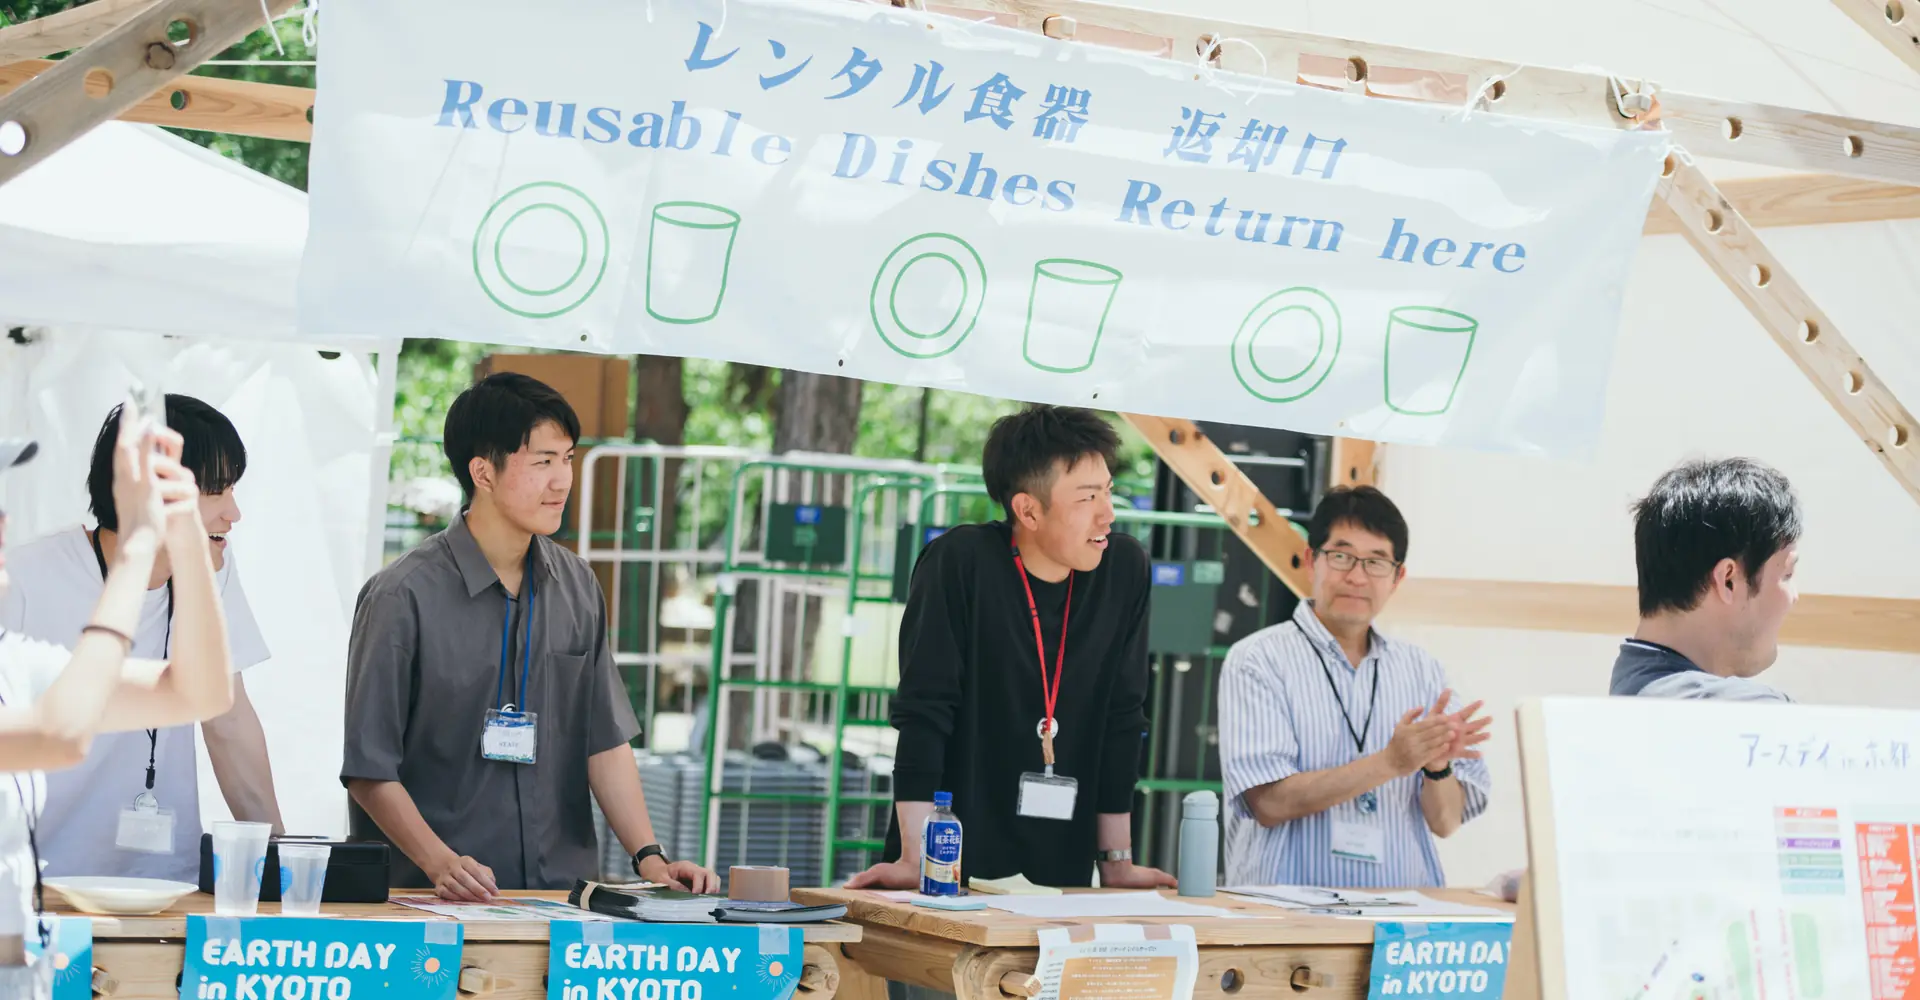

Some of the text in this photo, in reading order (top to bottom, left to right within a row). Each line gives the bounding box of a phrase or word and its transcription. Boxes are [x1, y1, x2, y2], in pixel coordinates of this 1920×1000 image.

[684, 21, 1349, 180] レンタル食器 返却口
[434, 78, 1528, 274] Reusable Dishes Return here
[202, 938, 397, 970] EARTH DAY
[565, 942, 742, 974] EARTH DAY
[1386, 940, 1466, 965] EARTH
[198, 973, 352, 1000] in KYOTO
[563, 976, 703, 1000] in KYOTO
[1381, 969, 1489, 995] in KYOTO
